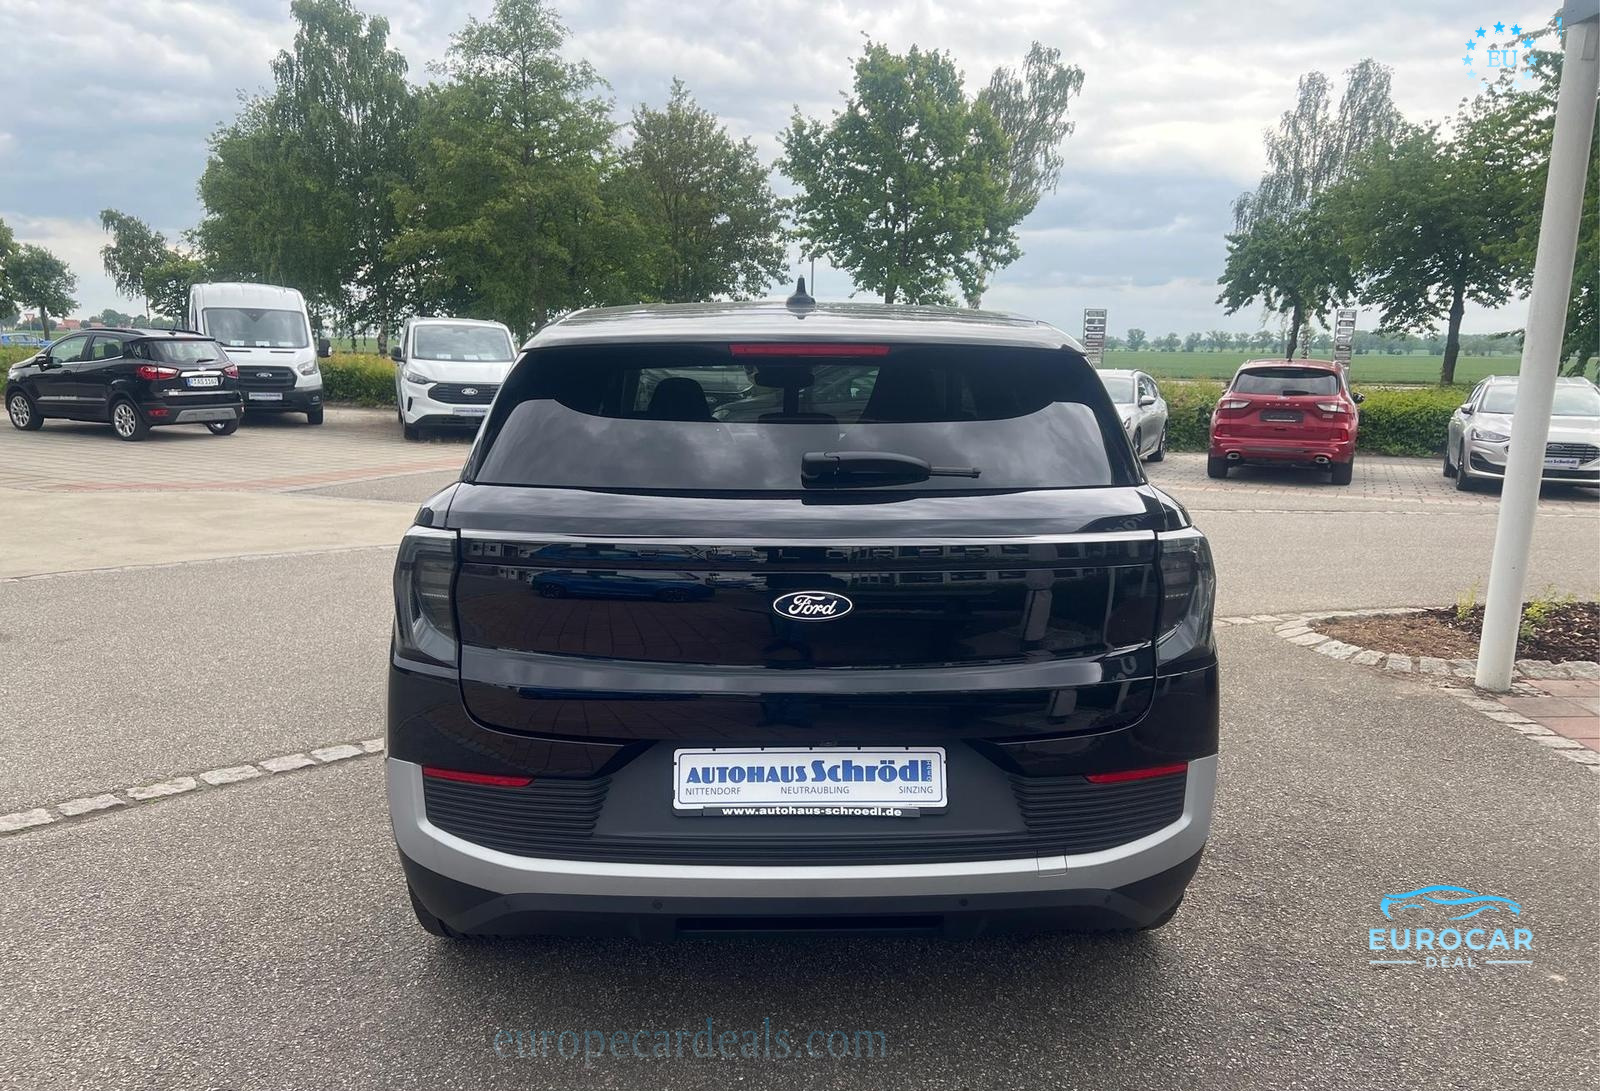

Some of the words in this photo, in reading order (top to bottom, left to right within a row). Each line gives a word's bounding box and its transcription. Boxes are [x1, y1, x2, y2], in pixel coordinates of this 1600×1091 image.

[788, 594, 838, 615] Ford
[686, 765, 808, 784] AUTOHAUS
[810, 759, 932, 783] Schrödl
[685, 786, 742, 796] NITTENDORF
[780, 785, 850, 795] NEUTRAUBLING
[898, 785, 934, 795] SINZING
[721, 806, 903, 818] www.autohaus-schroedl.de
